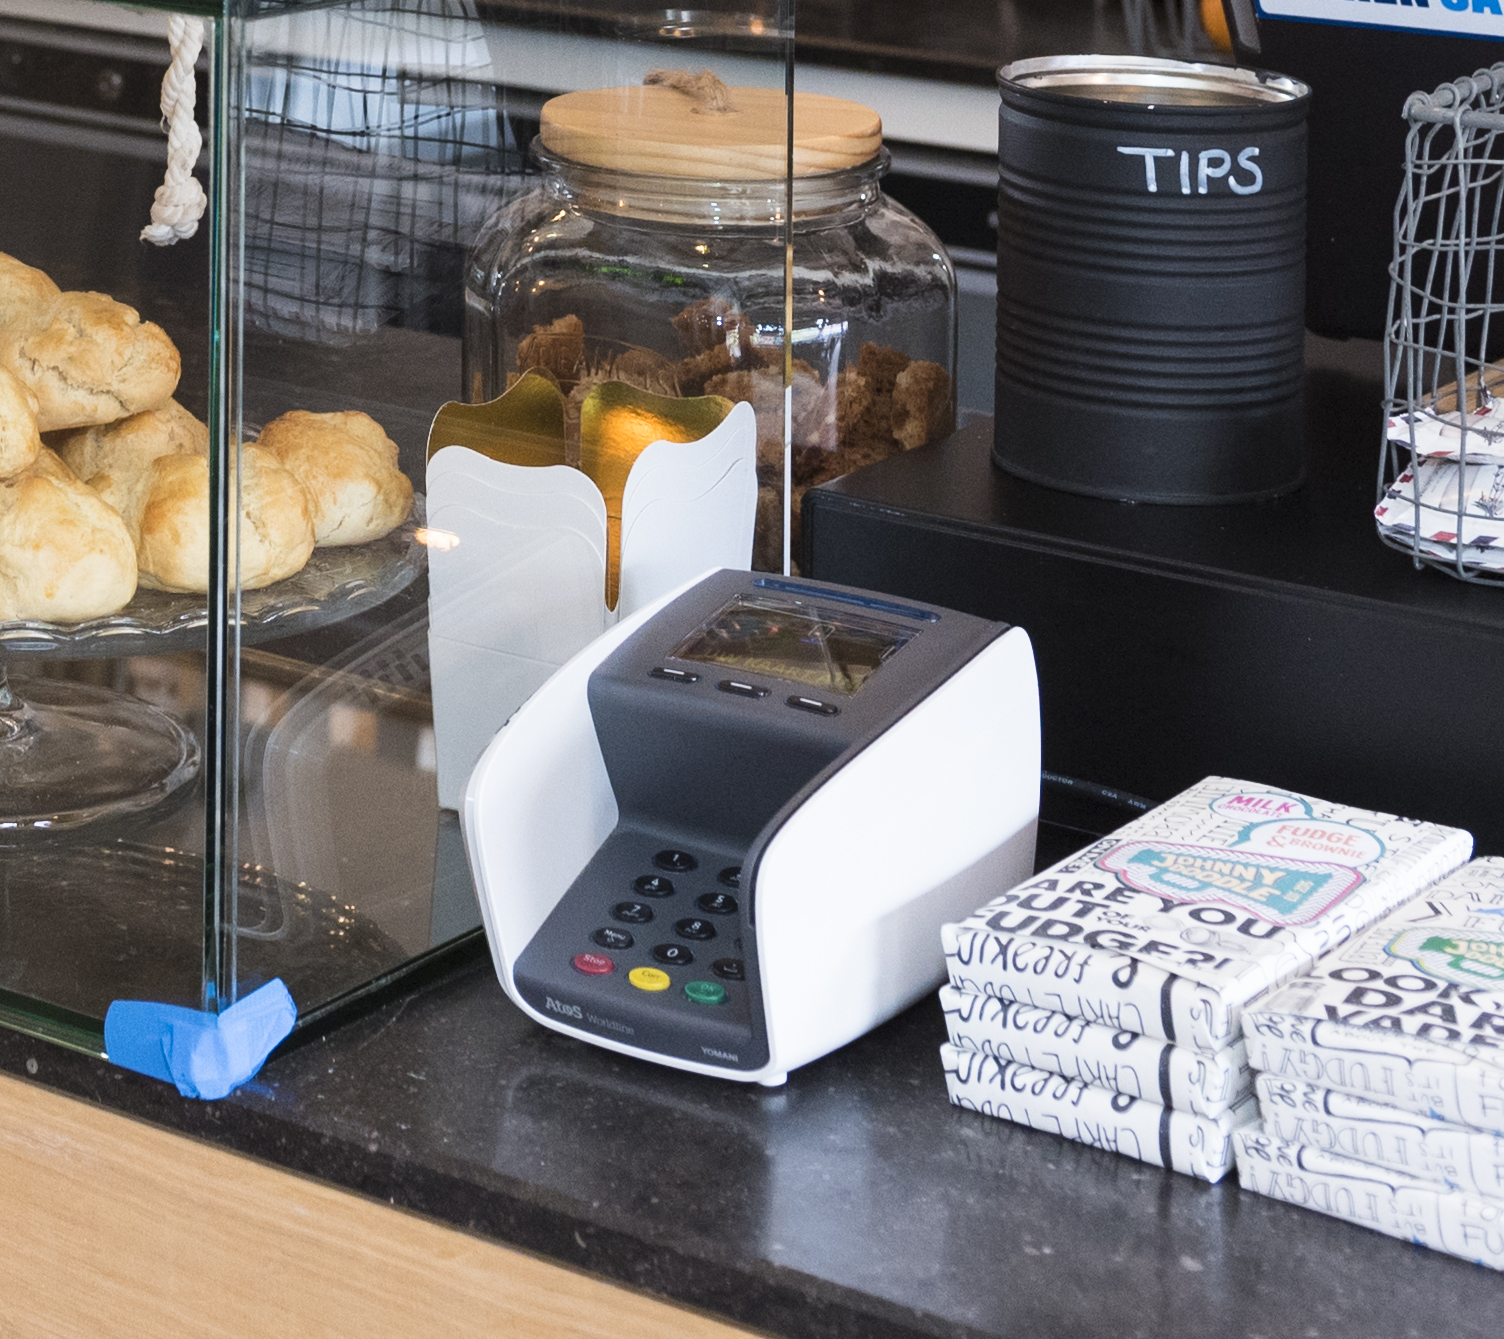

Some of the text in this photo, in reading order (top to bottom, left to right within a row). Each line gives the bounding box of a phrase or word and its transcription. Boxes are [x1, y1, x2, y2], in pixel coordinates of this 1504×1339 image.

[1116, 145, 1264, 197] TIPS
[1217, 803, 1284, 819] CHOCOLATE
[1226, 795, 1298, 814] MILK
[1265, 835, 1367, 860] & BROWNIE
[1276, 824, 1361, 847] FUDGE
[1152, 852, 1287, 886] JOHNNY
[1169, 866, 1283, 902] DOODLE
[1018, 878, 1286, 939] ARE YOU
[701, 1046, 739, 1062] YOMANI
